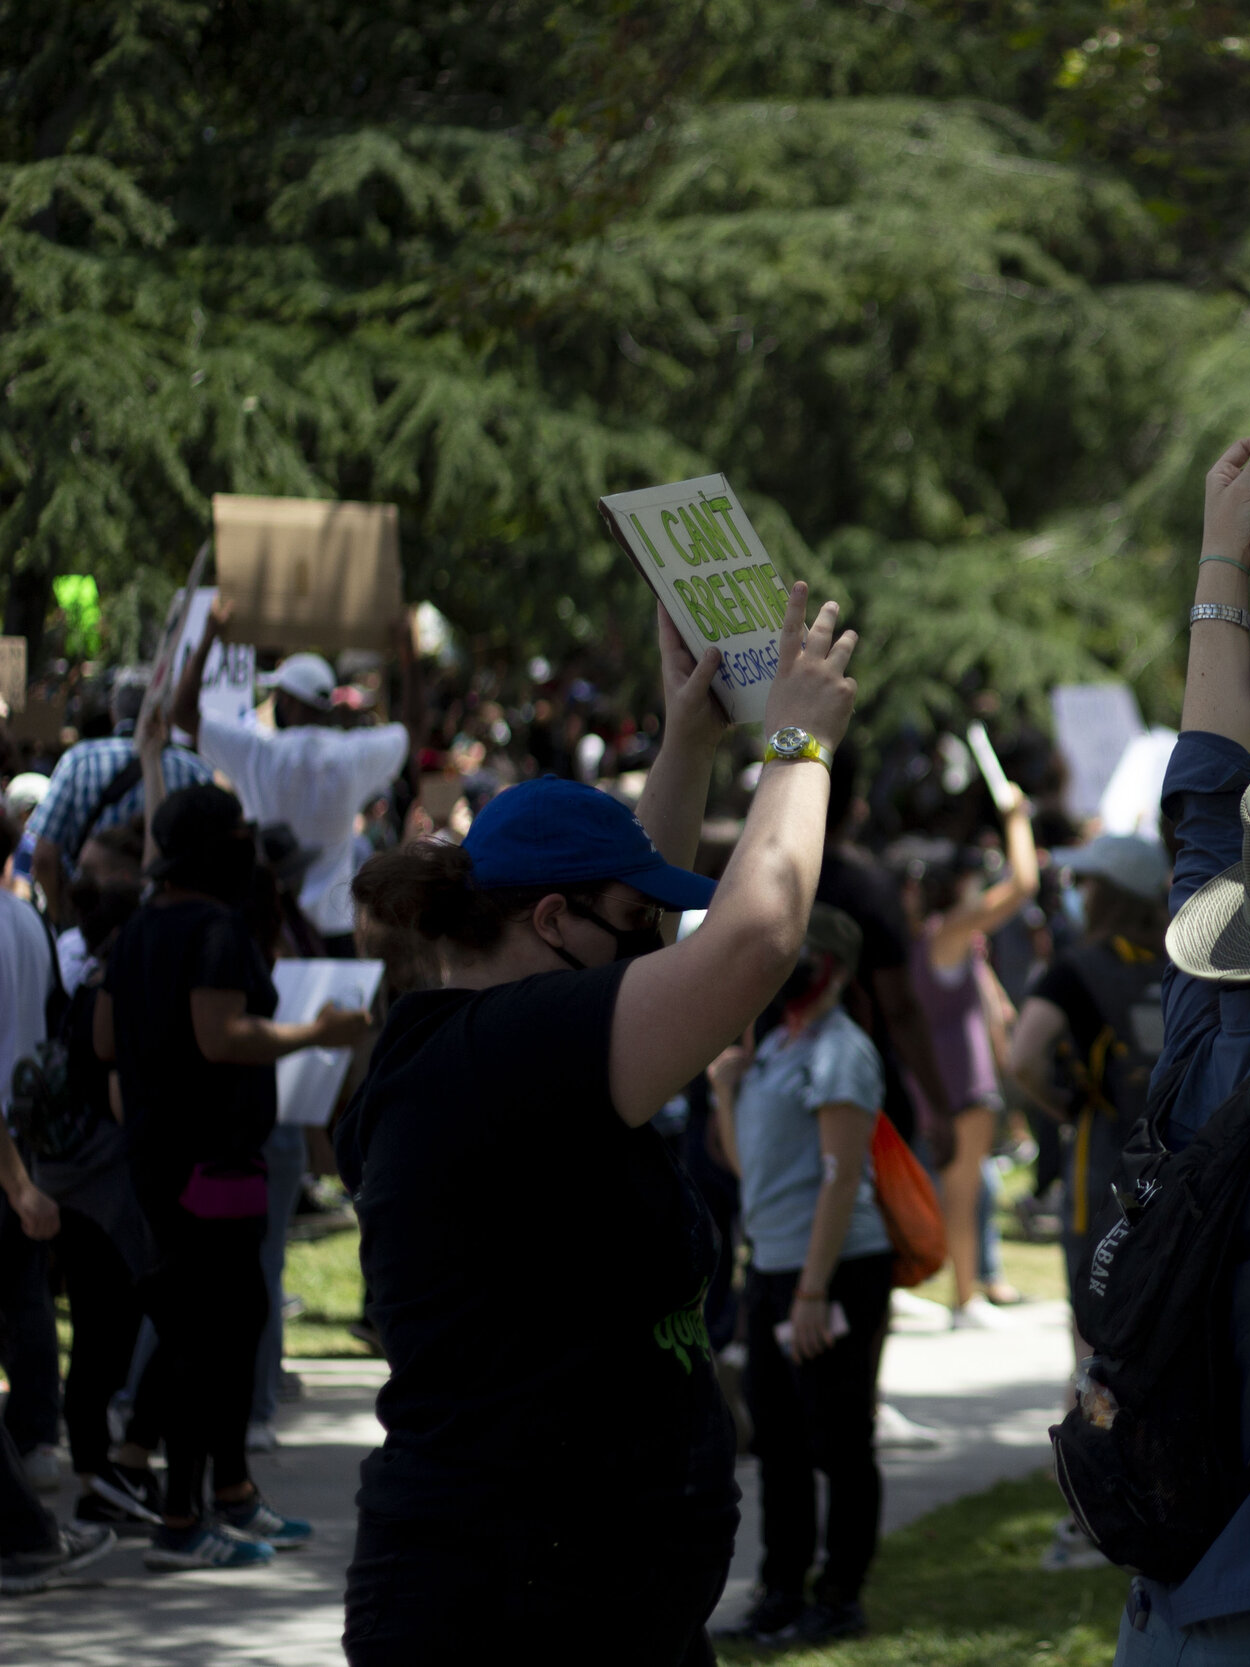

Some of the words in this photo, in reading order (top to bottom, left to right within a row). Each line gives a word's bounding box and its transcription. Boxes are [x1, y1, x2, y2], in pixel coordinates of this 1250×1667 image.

[630, 513, 665, 567] I
[661, 491, 752, 566] CAN'T
[1089, 1220, 1130, 1297] ELBAK
